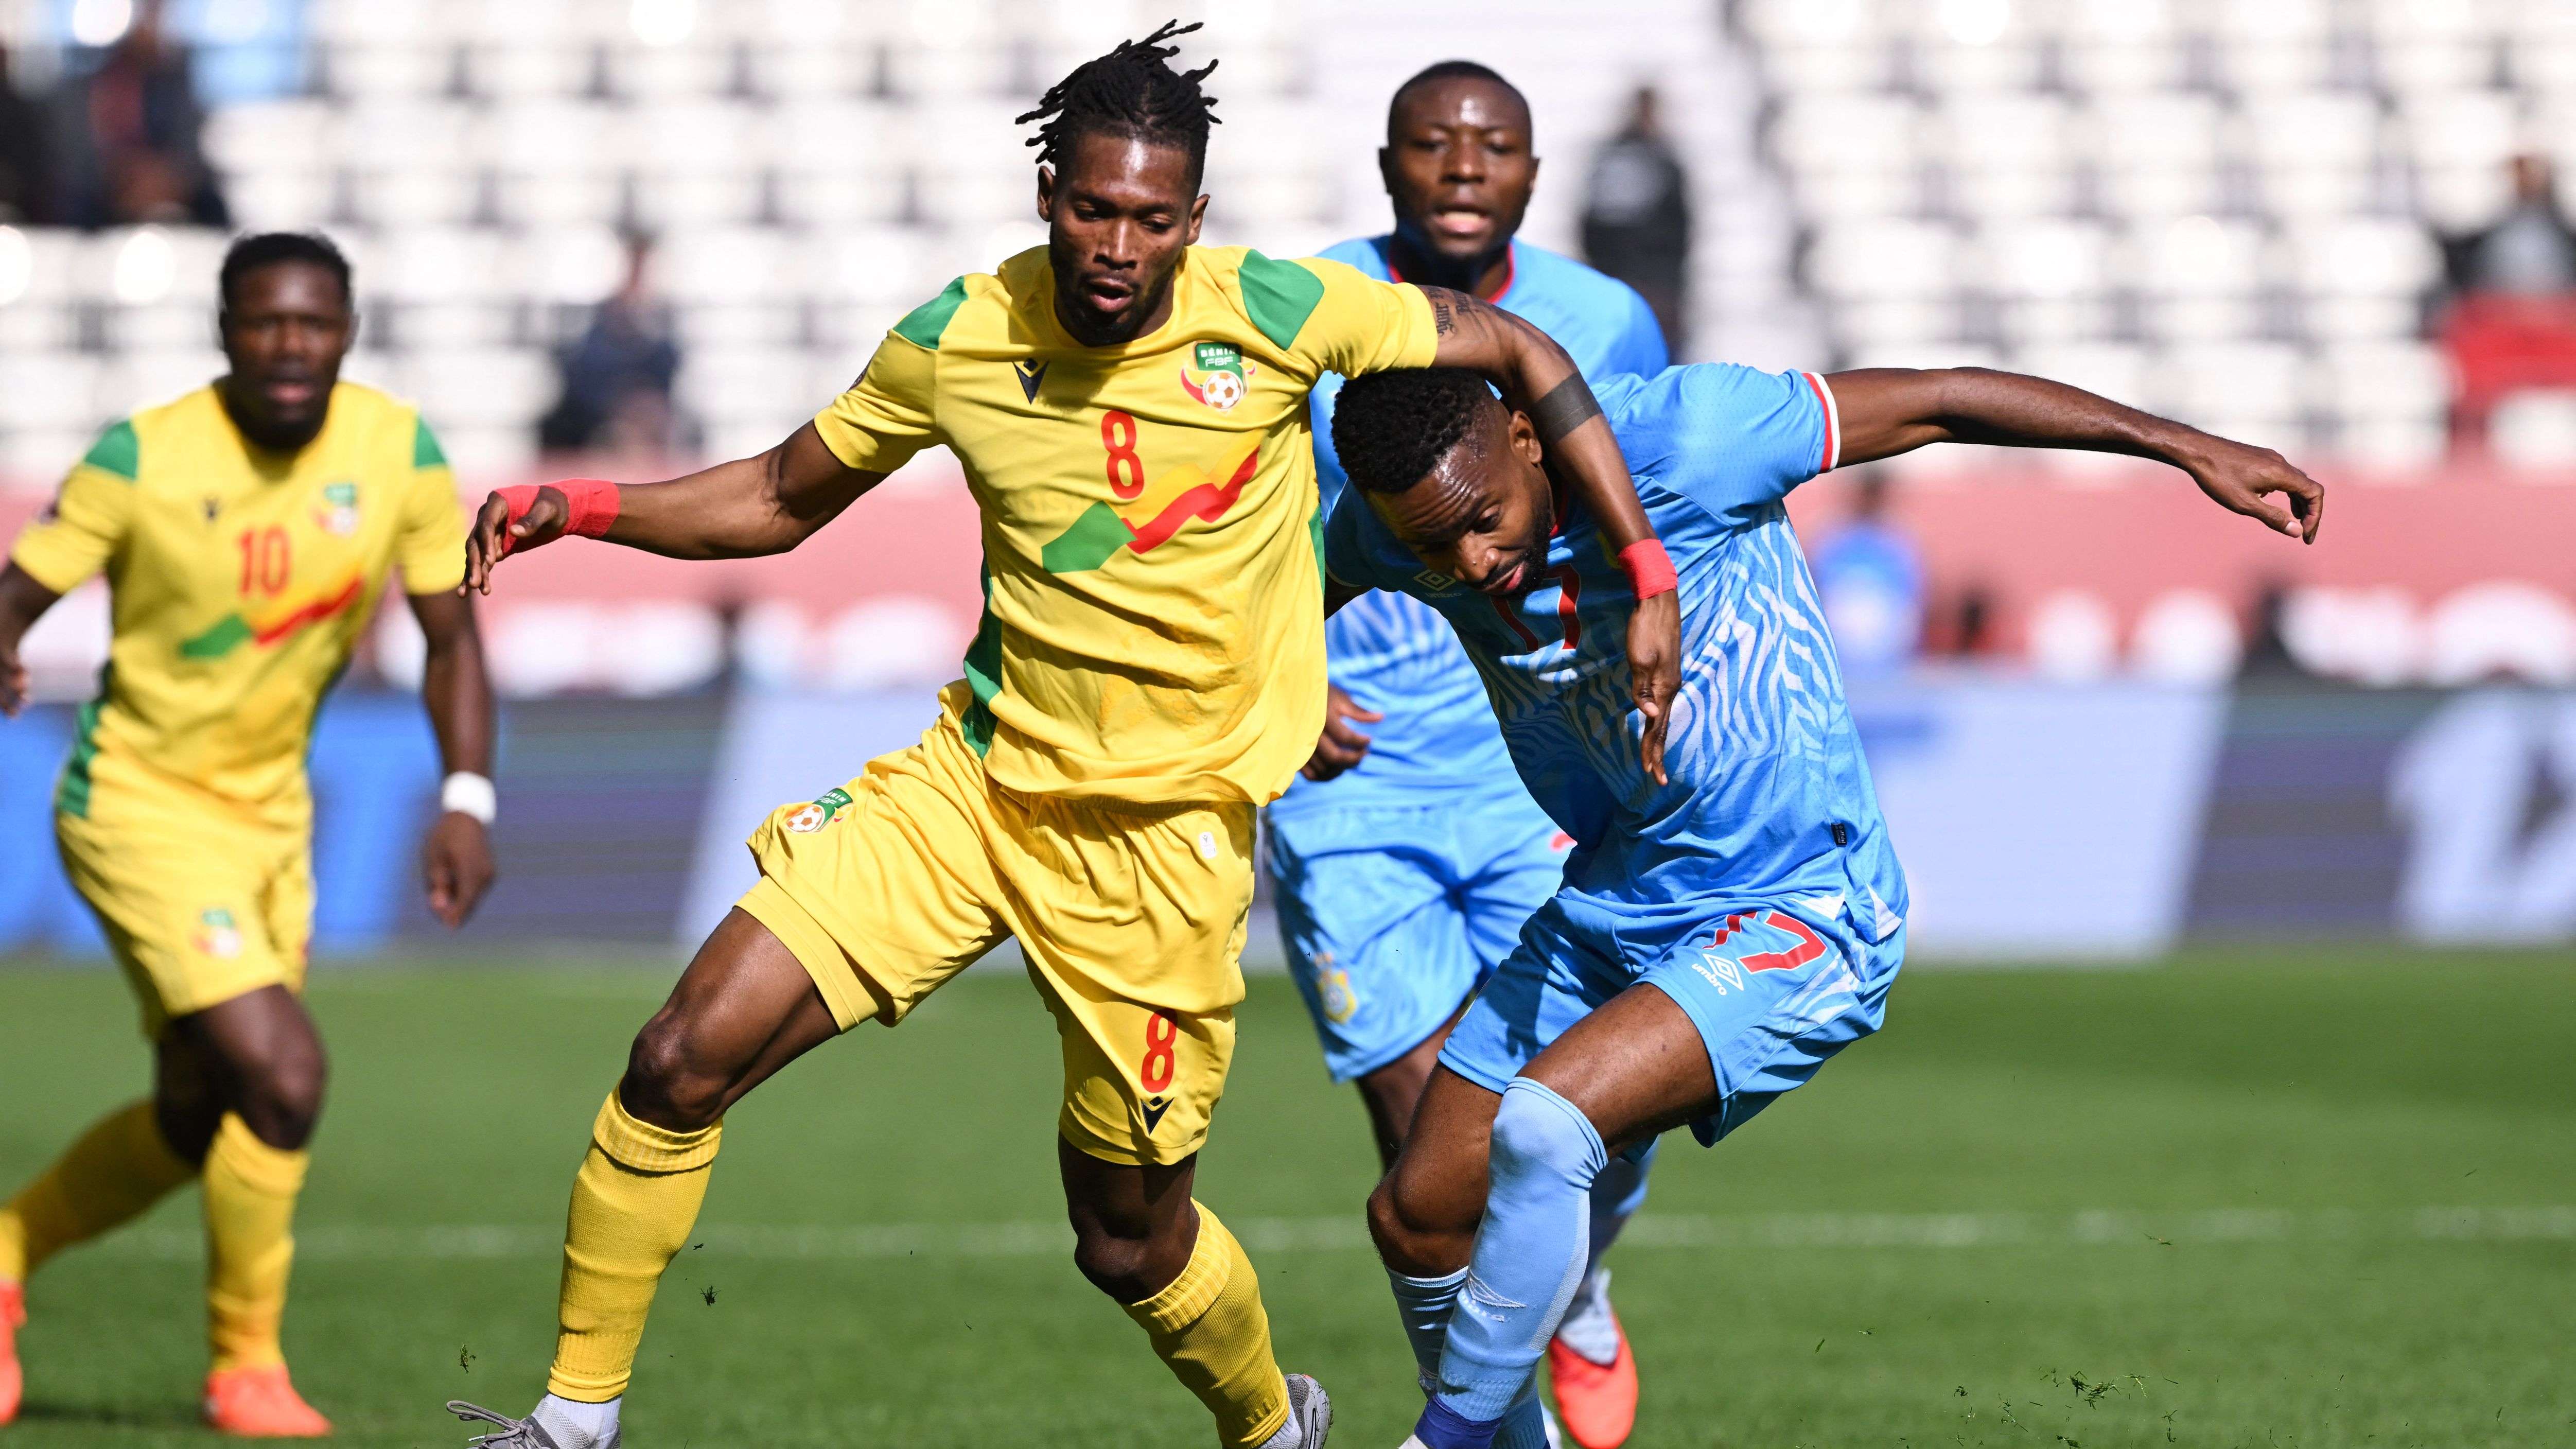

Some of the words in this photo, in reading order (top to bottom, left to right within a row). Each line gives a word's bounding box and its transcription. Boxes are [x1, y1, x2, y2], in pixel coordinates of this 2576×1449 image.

[1205, 356, 1233, 367] FBF
[1101, 410, 1144, 499] 8
[236, 524, 291, 598] 10
[1691, 963, 1727, 996] umbro
[1141, 1007, 1178, 1093] 8
